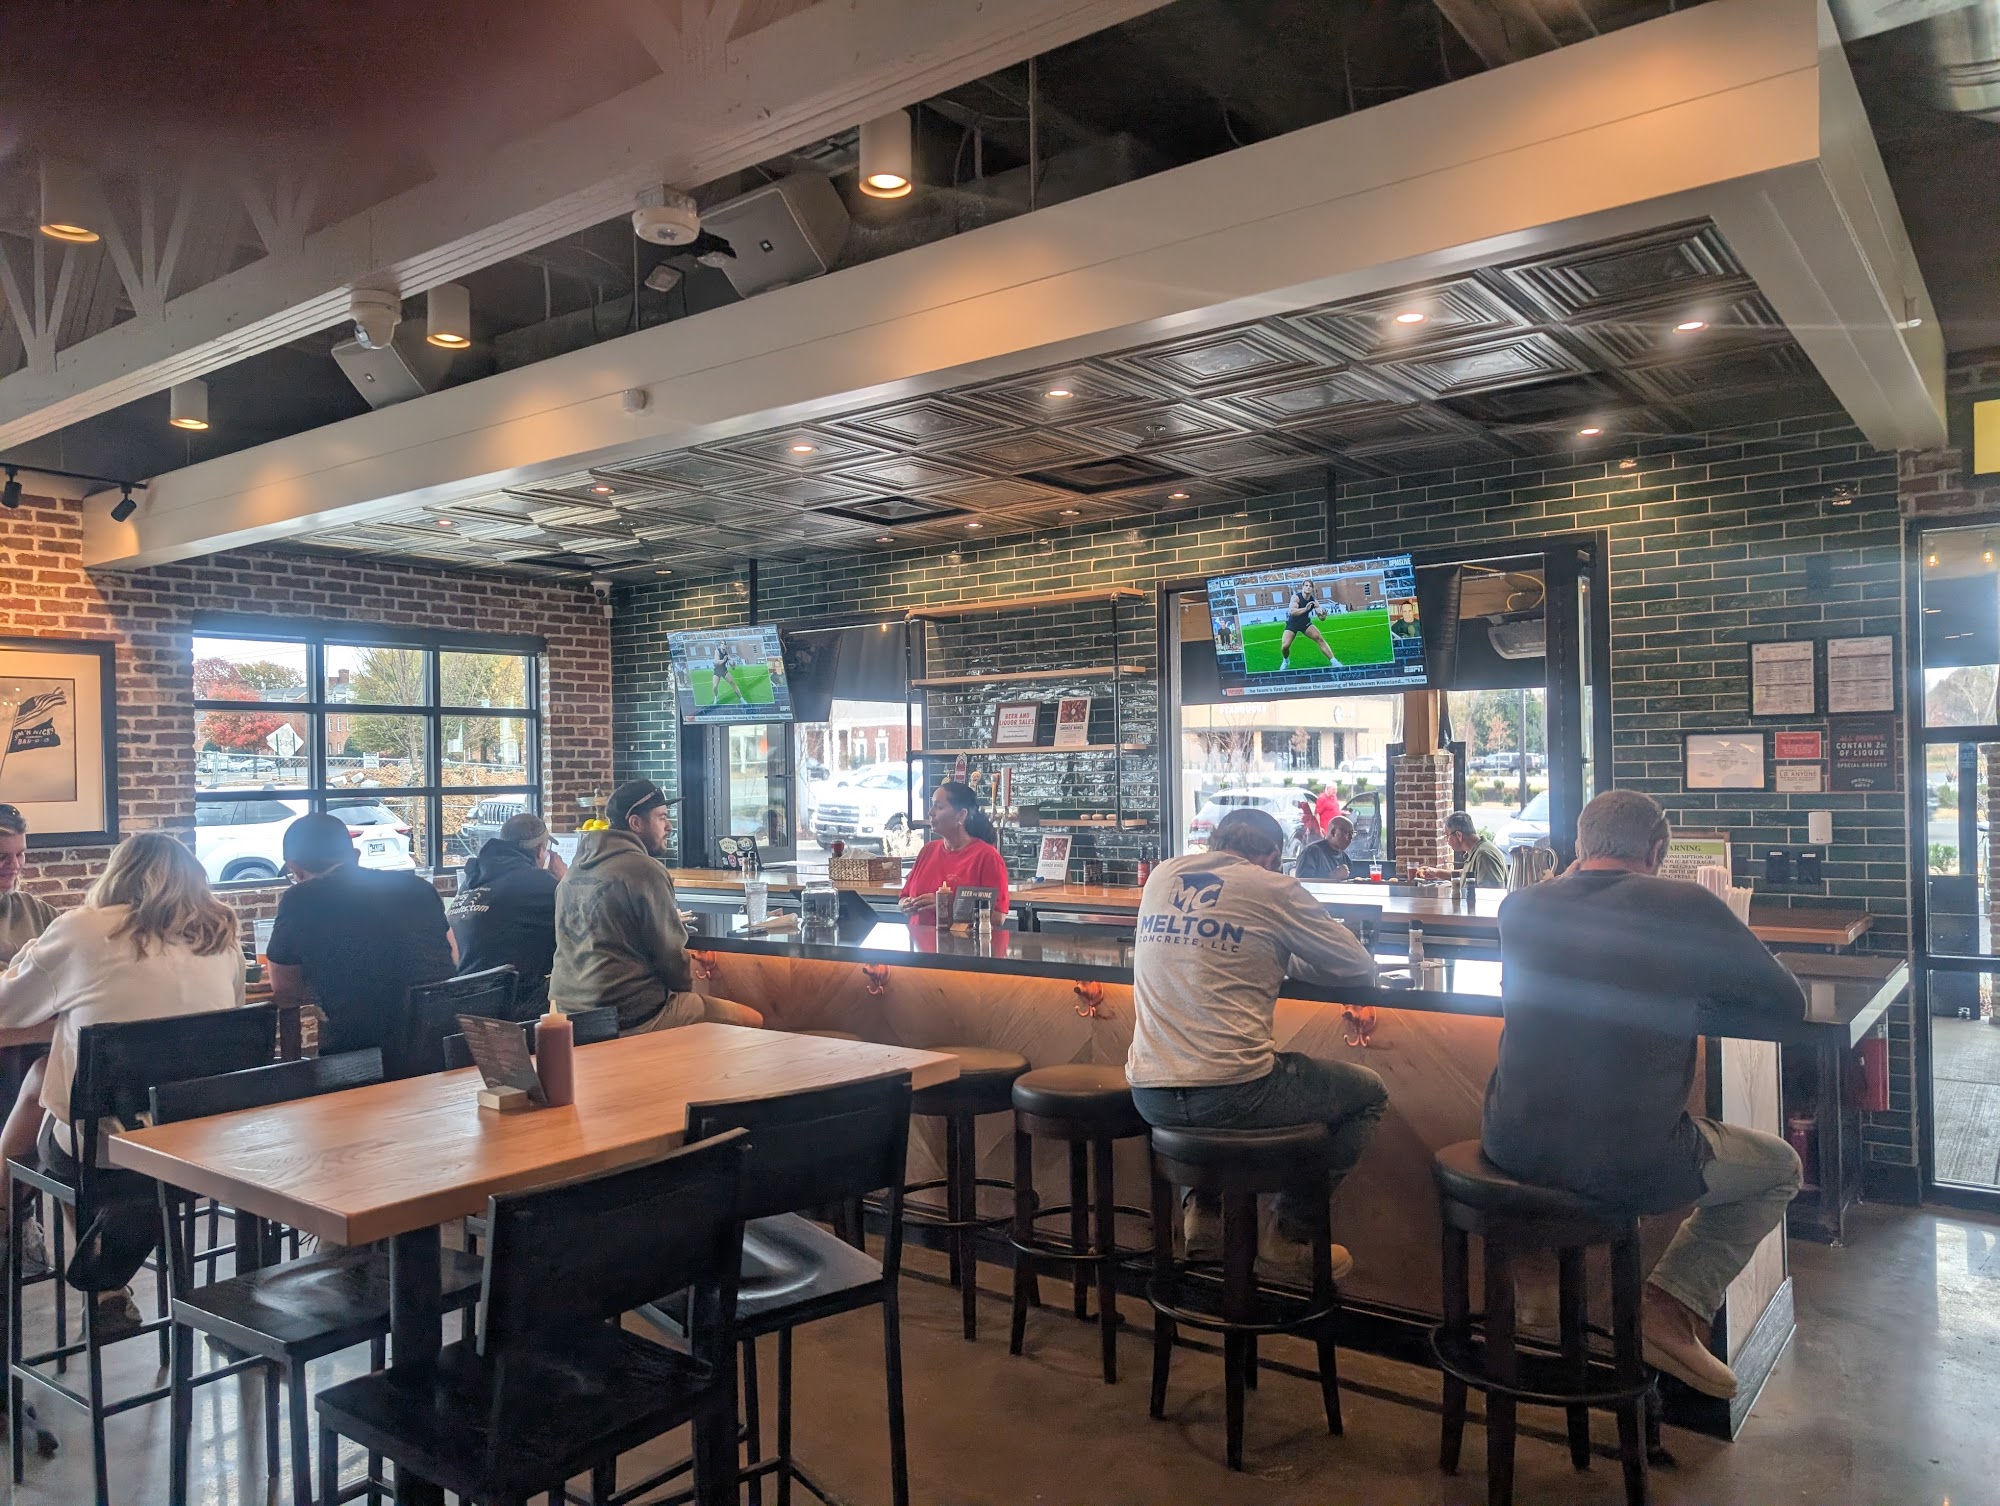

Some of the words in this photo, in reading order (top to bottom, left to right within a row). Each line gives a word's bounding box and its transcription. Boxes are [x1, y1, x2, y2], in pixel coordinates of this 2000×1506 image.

[1404, 665, 1424, 673] ESPN
[1348, 680, 1376, 688] Marshawn
[1669, 844, 1701, 852] ARNING
[1169, 876, 1221, 913] MC
[1141, 915, 1245, 943] MELTON
[1211, 941, 1241, 953] LLC
